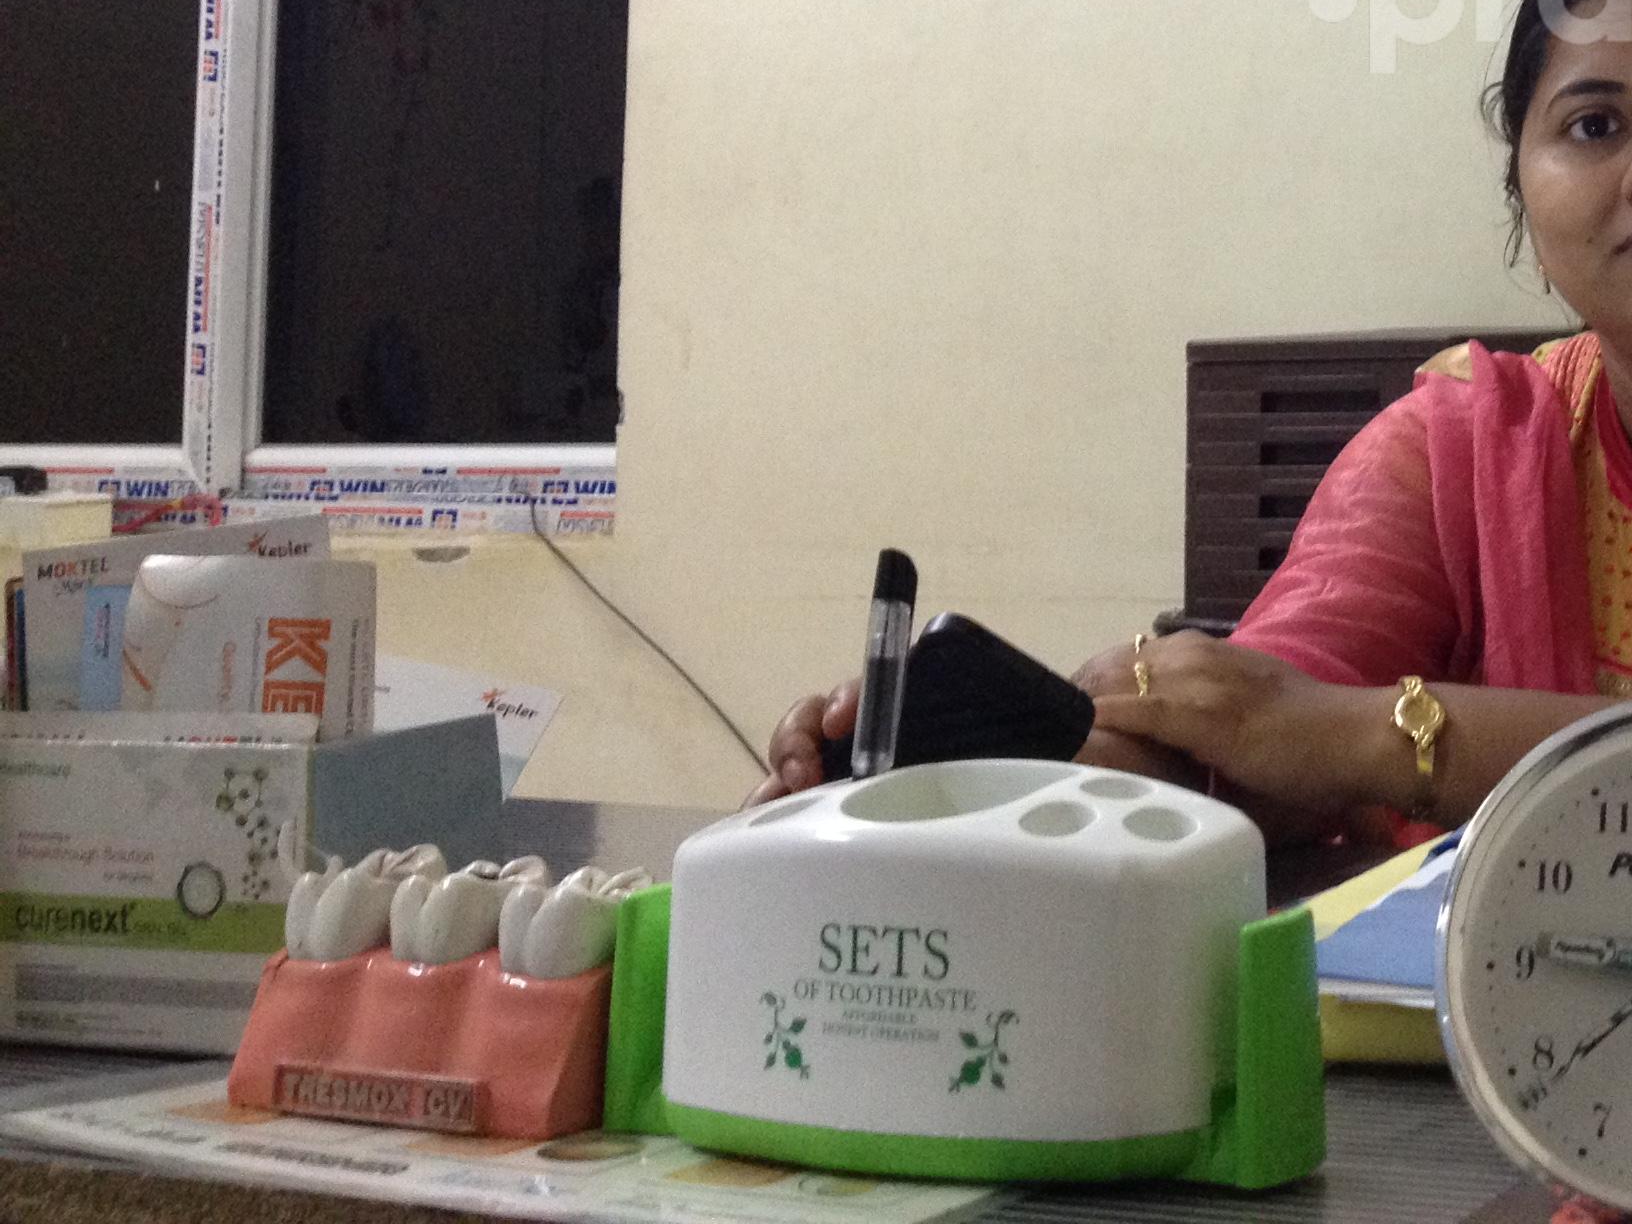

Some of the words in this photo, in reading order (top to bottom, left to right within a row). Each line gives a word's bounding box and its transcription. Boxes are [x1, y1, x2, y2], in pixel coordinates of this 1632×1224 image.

[127, 479, 169, 497] WIN
[339, 479, 385, 493] WIN
[486, 697, 539, 721] Kepler
[1598, 801, 1630, 833] 11
[1535, 860, 1573, 894] 10
[15, 902, 130, 936] curenext
[818, 922, 951, 981] SETS
[1515, 946, 1536, 981] 9
[793, 977, 820, 1001] OF
[827, 981, 977, 1012] TOOTHPASTE
[1532, 1037, 1555, 1071] 8
[1593, 1102, 1611, 1139] 7
